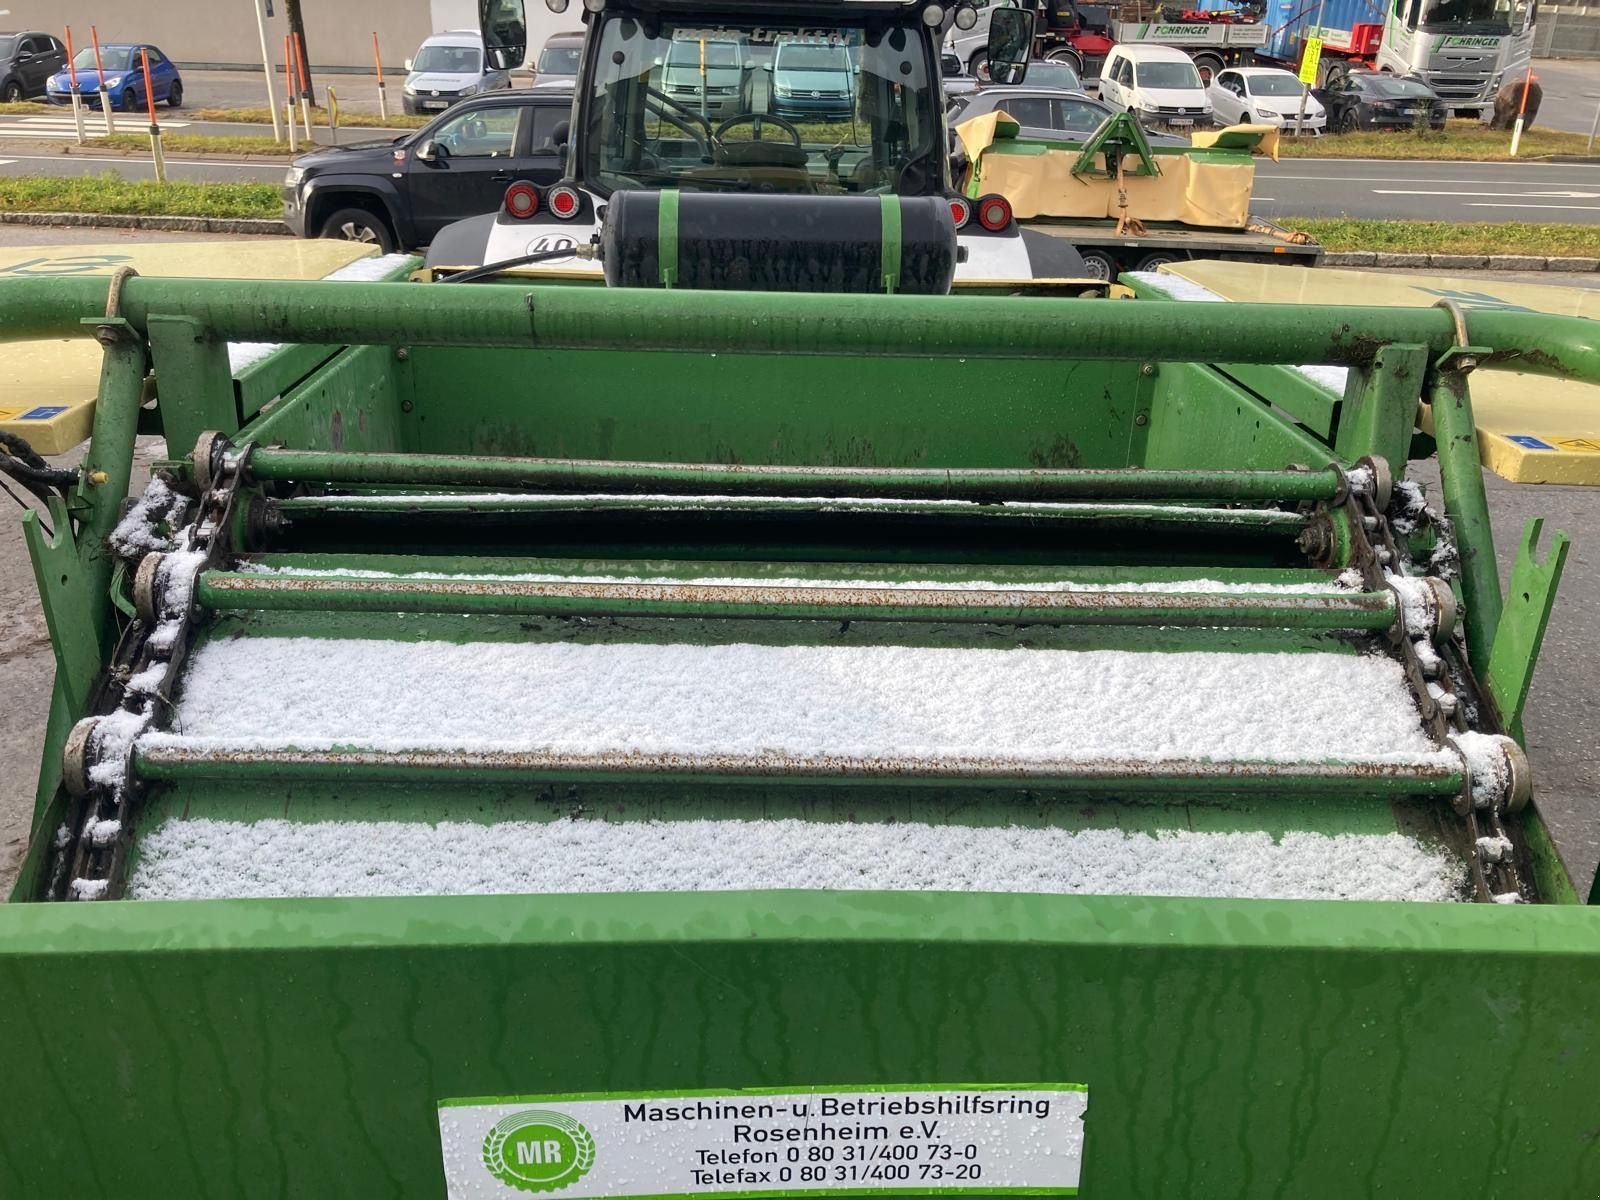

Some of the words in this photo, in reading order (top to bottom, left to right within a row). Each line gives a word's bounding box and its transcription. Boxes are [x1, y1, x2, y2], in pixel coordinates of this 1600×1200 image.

[532, 238, 573, 254] 40
[821, 1095, 1050, 1119] Betriebshilfsring
[734, 1122, 888, 1143] Rosenheim
[900, 1121, 941, 1139] e.V.
[516, 1140, 562, 1165] MR
[695, 1149, 778, 1165] Telefon
[787, 1147, 800, 1162] 0
[808, 1146, 834, 1162] 80
[842, 1145, 918, 1161] 31/400
[928, 1144, 977, 1160] 73-0
[690, 1168, 771, 1185] Telefax
[779, 1166, 792, 1182] 0
[800, 1166, 826, 1181] 80
[834, 1165, 910, 1180] 31/400
[919, 1164, 982, 1180] 73-20
